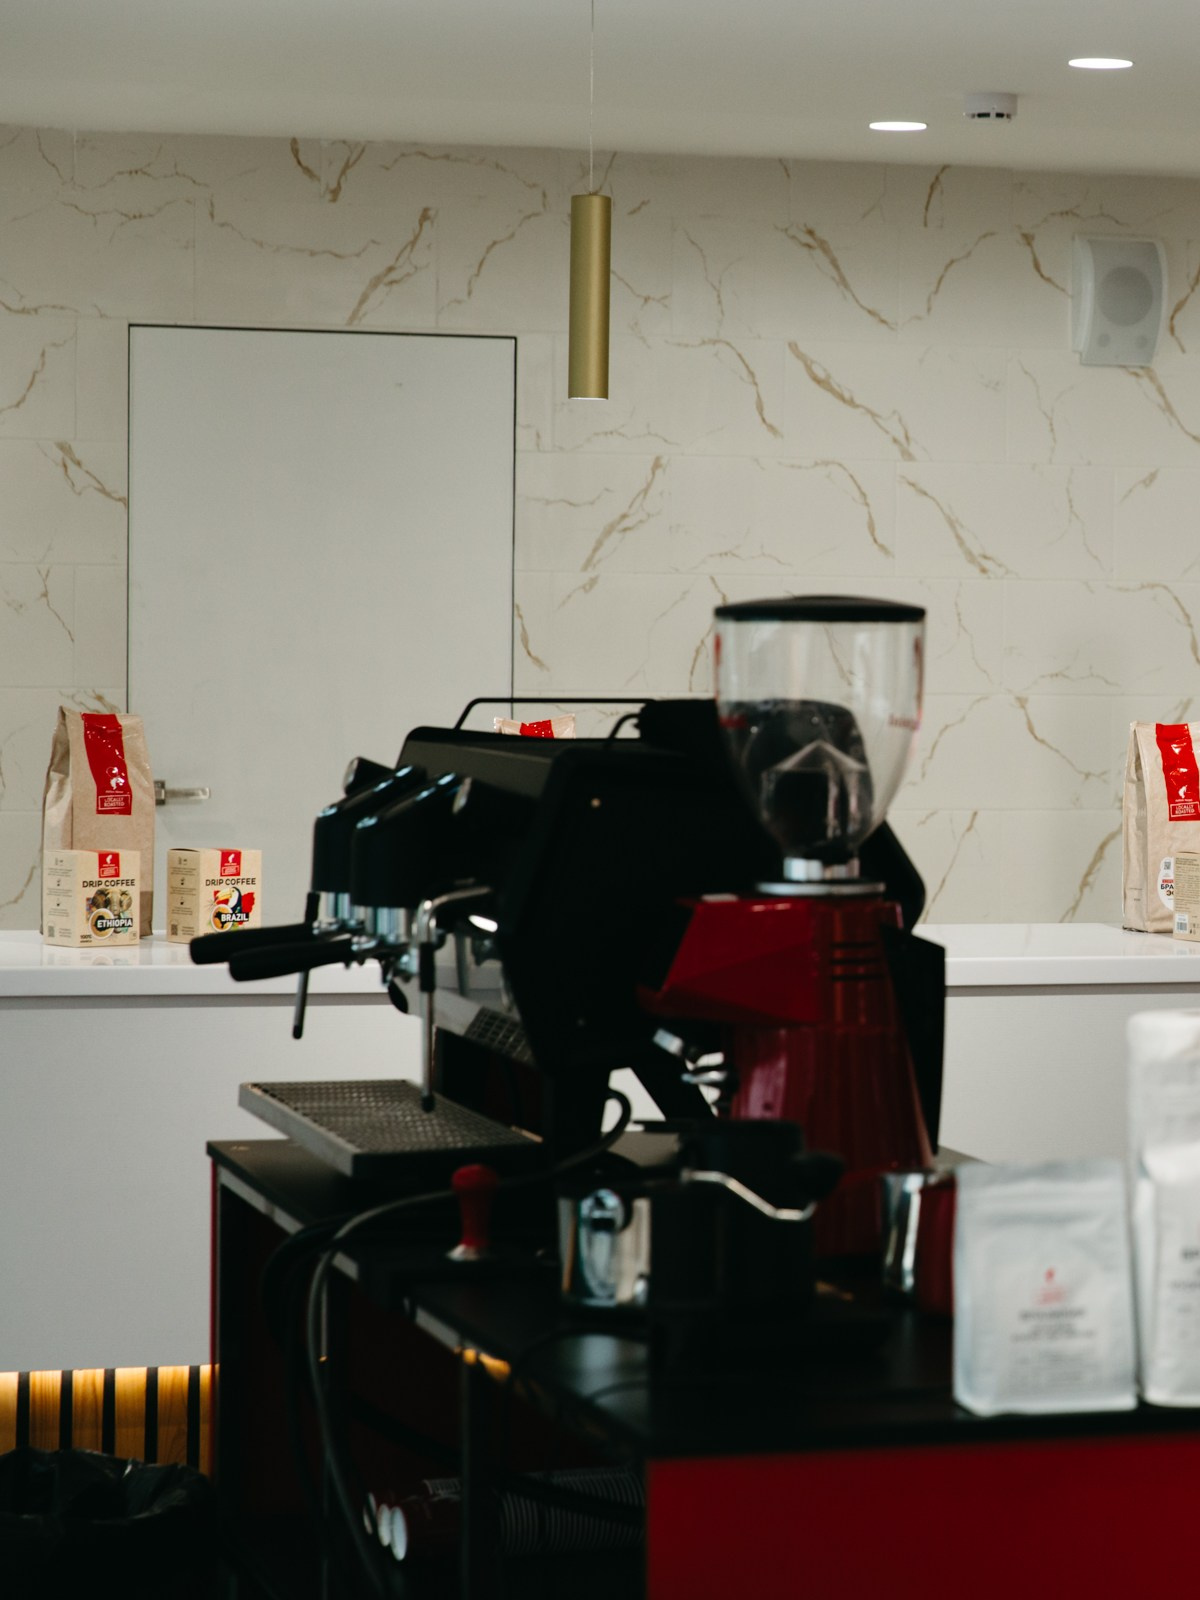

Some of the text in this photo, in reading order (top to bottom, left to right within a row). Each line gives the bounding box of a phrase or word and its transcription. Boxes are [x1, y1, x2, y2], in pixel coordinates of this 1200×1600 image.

[82, 879, 136, 888] DRIP COFFEE
[205, 878, 257, 887] DRIP COFFEE
[221, 913, 248, 921] BRAZIL
[97, 919, 132, 928] ETHIOPIA
